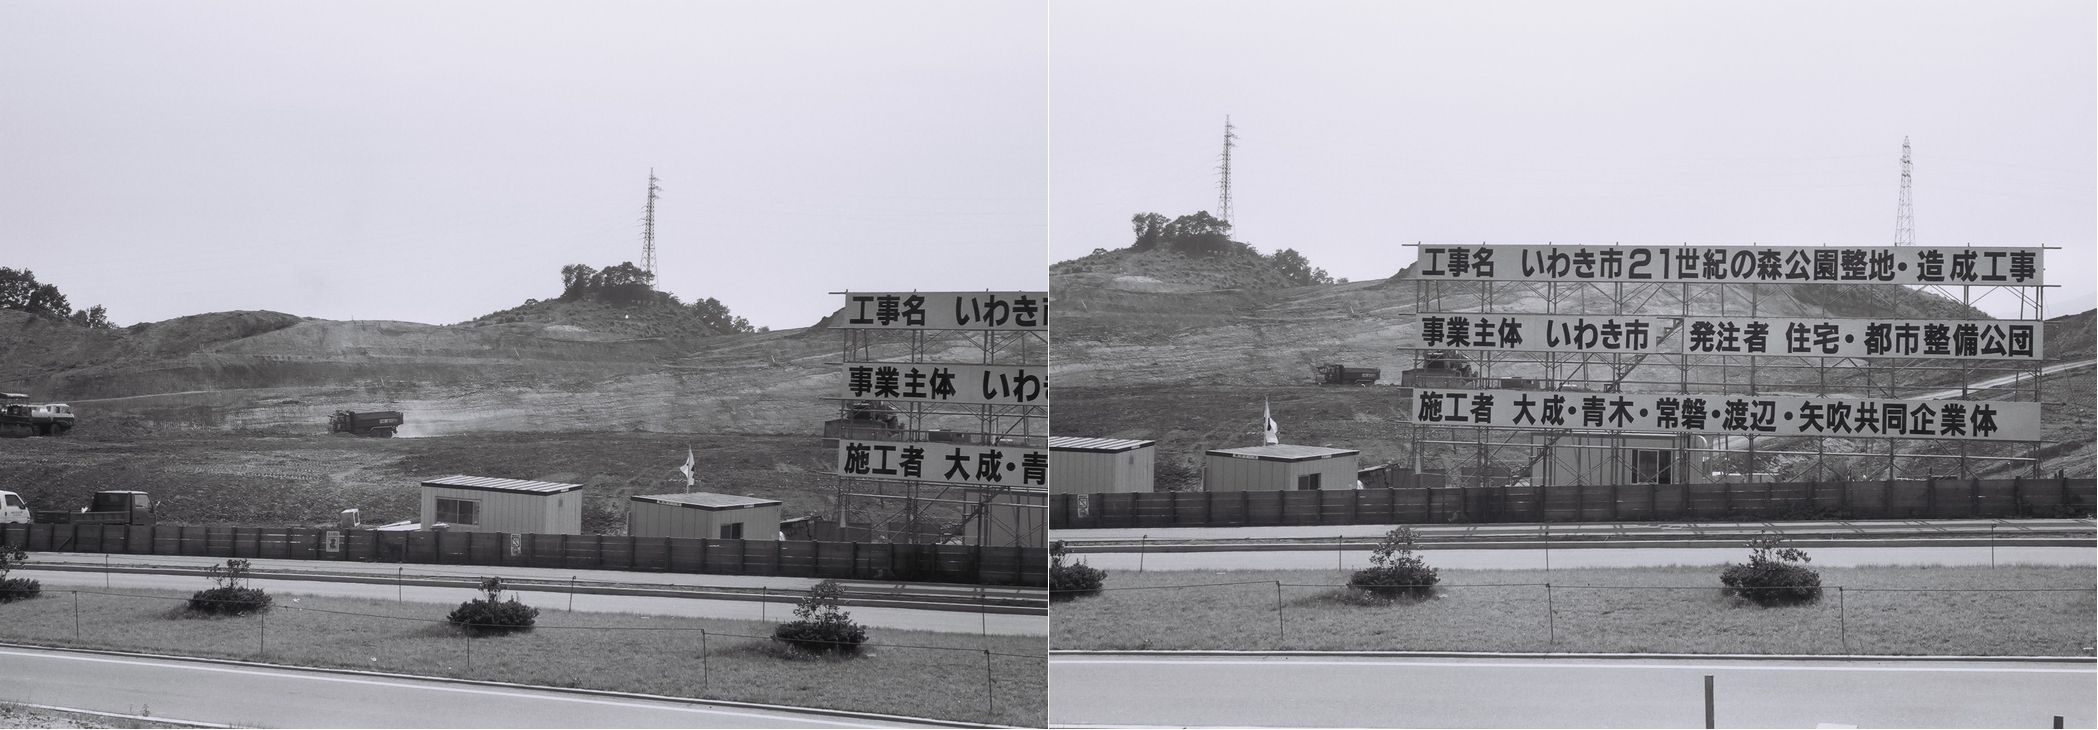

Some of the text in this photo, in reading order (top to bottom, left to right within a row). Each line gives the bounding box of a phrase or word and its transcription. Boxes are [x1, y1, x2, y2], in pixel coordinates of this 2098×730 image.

[1422, 247, 1494, 278] 工事名
[850, 295, 1047, 328] 工事名 いわき
[1422, 316, 1649, 350] 事業主体 いわき市
[1690, 321, 2034, 357] 発注者 住宅・都市整備公団
[849, 366, 1047, 403] 事業主体 いわ
[1418, 391, 1494, 424] 施工者
[844, 443, 1047, 485] 施工者 大成・青
